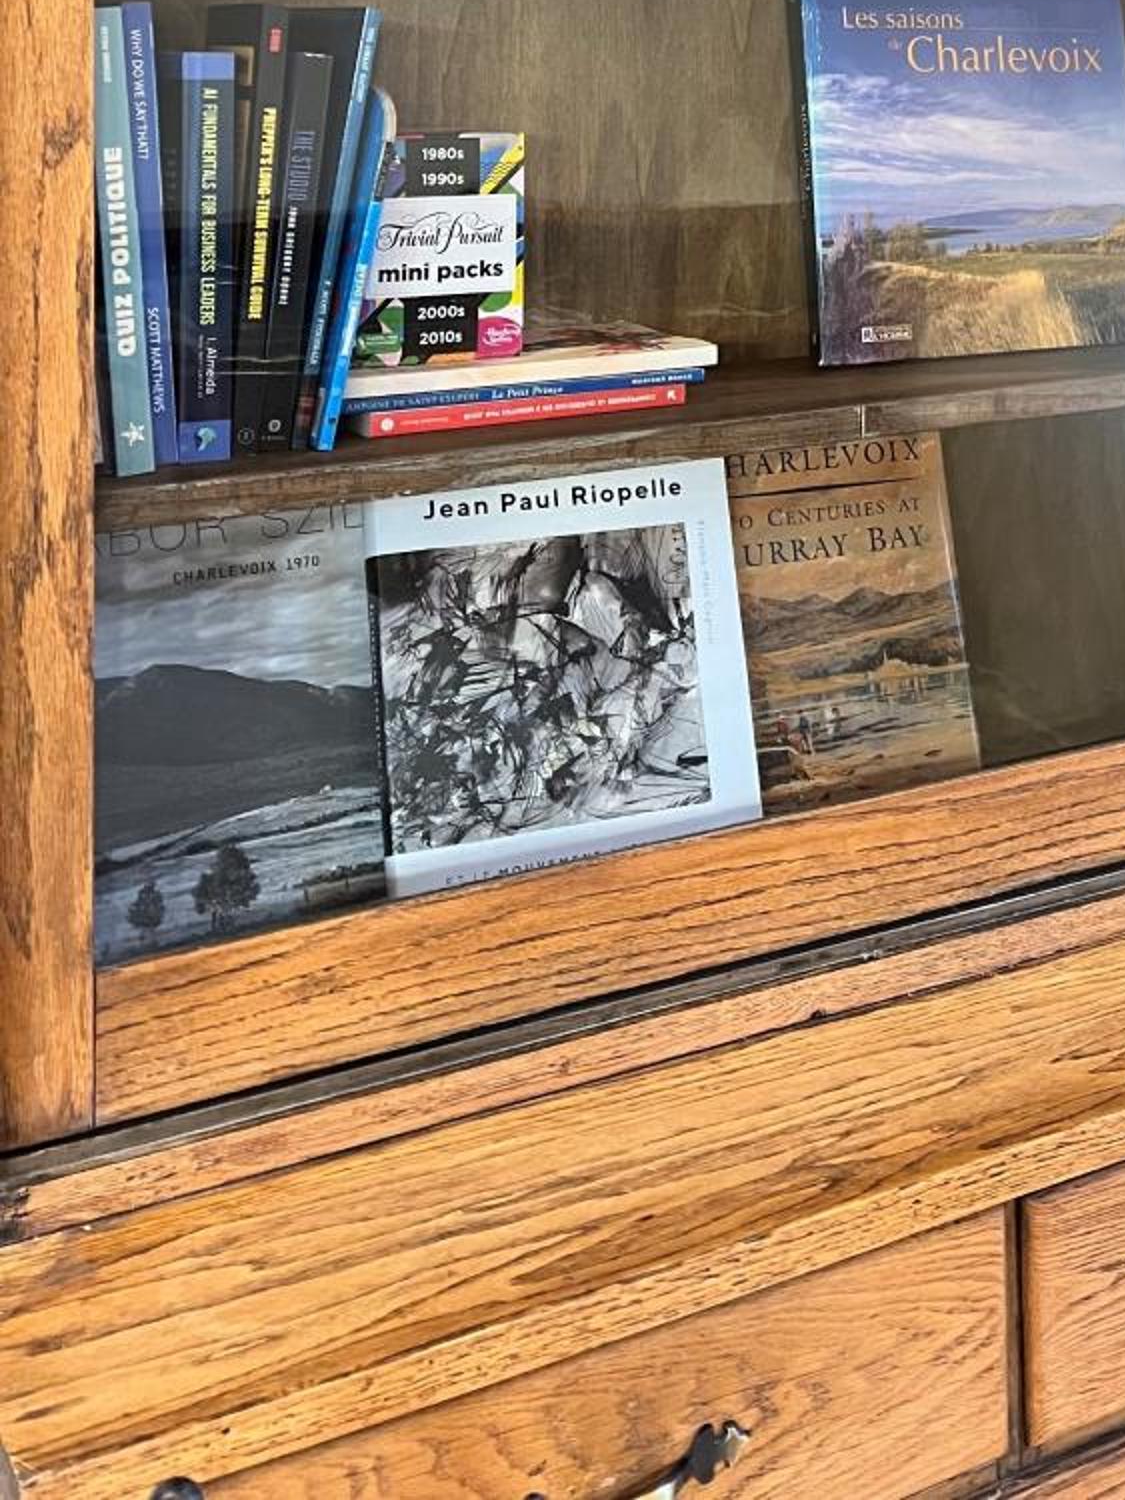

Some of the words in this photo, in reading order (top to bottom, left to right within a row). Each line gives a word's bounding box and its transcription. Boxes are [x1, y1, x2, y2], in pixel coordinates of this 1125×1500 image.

[842, 6, 879, 30] Les
[886, 7, 964, 30] saisons
[130, 29, 142, 58] WHY
[907, 33, 1102, 73] Charlevoix
[131, 59, 145, 79] DO
[132, 79, 145, 99] WE
[202, 87, 219, 99] AI
[134, 101, 148, 121] SAY
[201, 103, 219, 194] FUNDAMENTALS
[259, 107, 277, 165] PREPPER'S
[292, 131, 316, 150] THE
[422, 147, 465, 161] 1980s
[287, 155, 313, 202] STUDIO
[422, 172, 465, 186] 1990s
[103, 147, 132, 285] POLITIQUE
[201, 196, 217, 215] FOR
[254, 167, 273, 229] LONG-TERM
[201, 220, 217, 273] BUSINESS
[377, 214, 441, 252] Trivial
[437, 212, 504, 254] Pursuit
[250, 231, 268, 284] SURVIVAL
[378, 263, 430, 284] mini
[437, 261, 504, 284] packs
[199, 277, 215, 326] LEADERS
[247, 285, 264, 320] GUIDE
[417, 305, 465, 320] 2000s
[114, 293, 137, 357] QUIZ
[147, 307, 160, 345] SCOTT
[419, 331, 462, 345] 2010s
[151, 346, 166, 414] MATTHEWS
[204, 348, 217, 395] Almeida
[491, 389, 503, 399] Le
[506, 386, 529, 398] Petit
[725, 437, 920, 478] HARLEVOIX
[424, 499, 489, 520] Jean
[500, 488, 559, 512] Paul
[571, 478, 681, 506] Riopelle
[767, 499, 886, 527] CENTURIES
[899, 497, 920, 513] AT
[742, 533, 848, 567] URRAY
[867, 524, 924, 552] BAY
[173, 559, 277, 585] CHARLEVOIX
[285, 555, 320, 571] 1970
